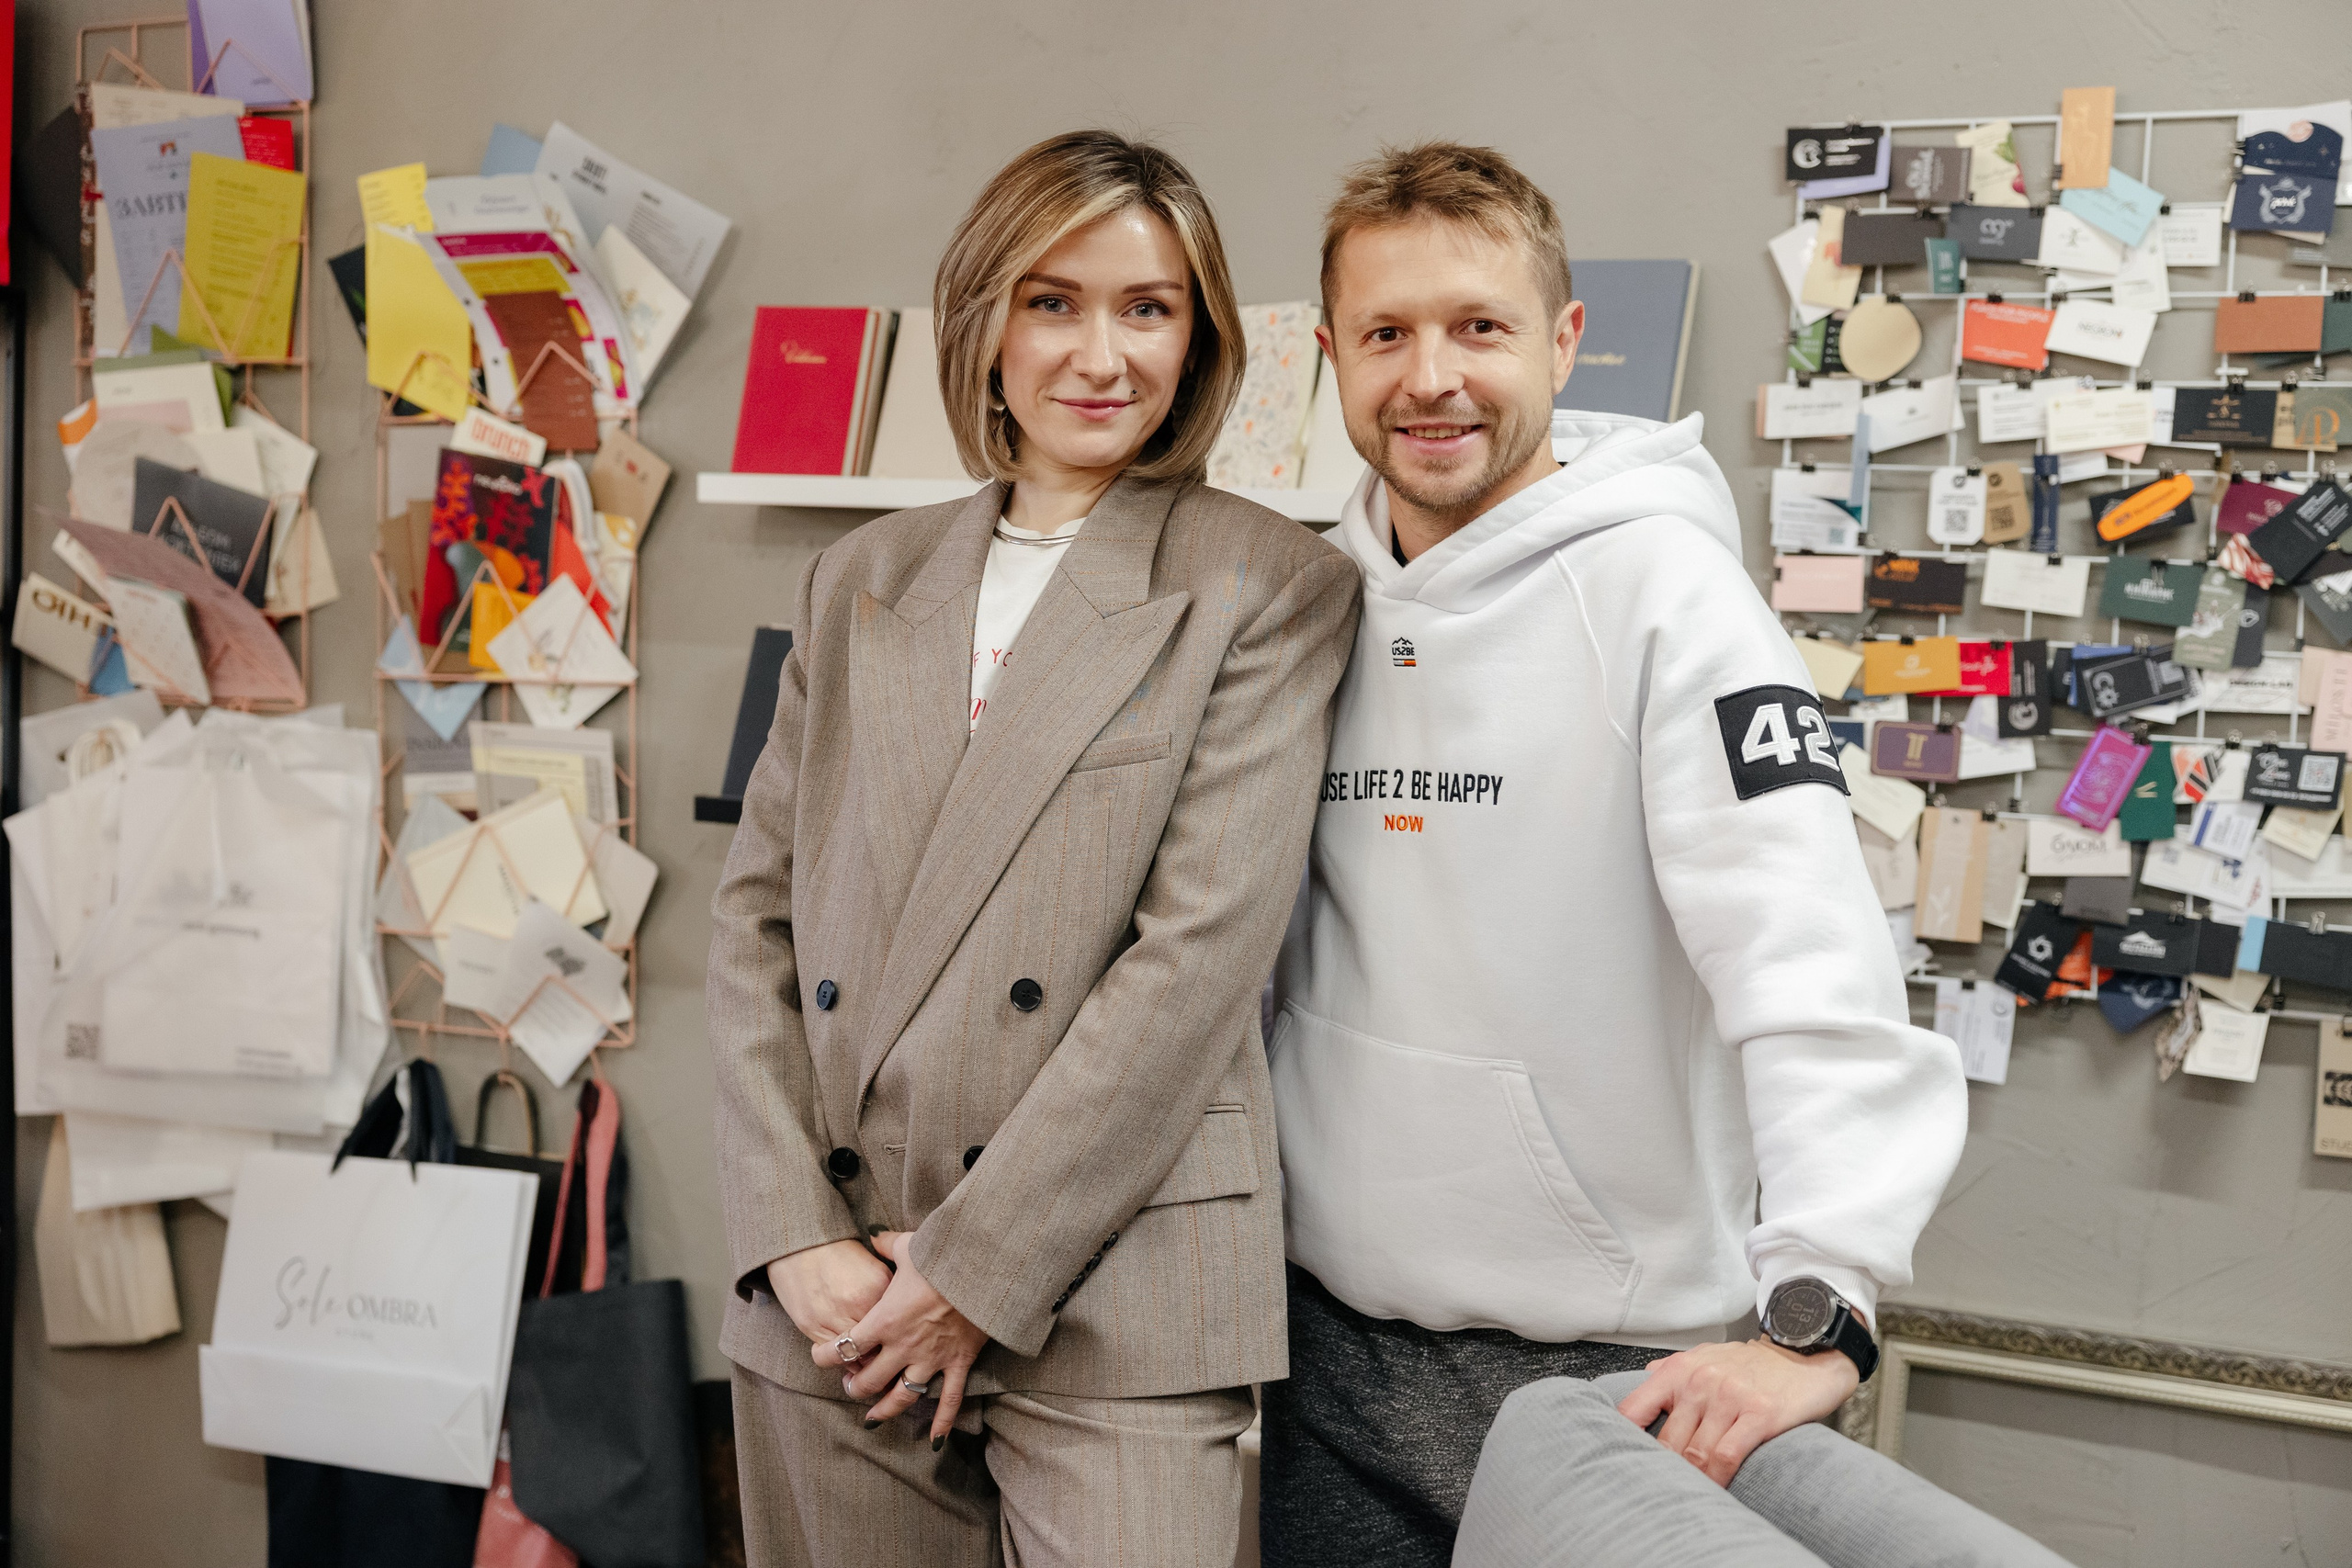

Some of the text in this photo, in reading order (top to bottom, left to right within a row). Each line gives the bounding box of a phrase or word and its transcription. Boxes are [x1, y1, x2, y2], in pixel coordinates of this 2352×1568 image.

[1391, 646, 1415, 656] US2BE
[1741, 703, 1840, 772] 42
[1354, 770, 1388, 800] LIFE
[1393, 769, 1404, 798] 2
[1411, 770, 1432, 800] BE
[1438, 773, 1503, 806] HAPPY
[1385, 814, 1423, 833] NOW
[346, 1292, 438, 1329] OMBRA
